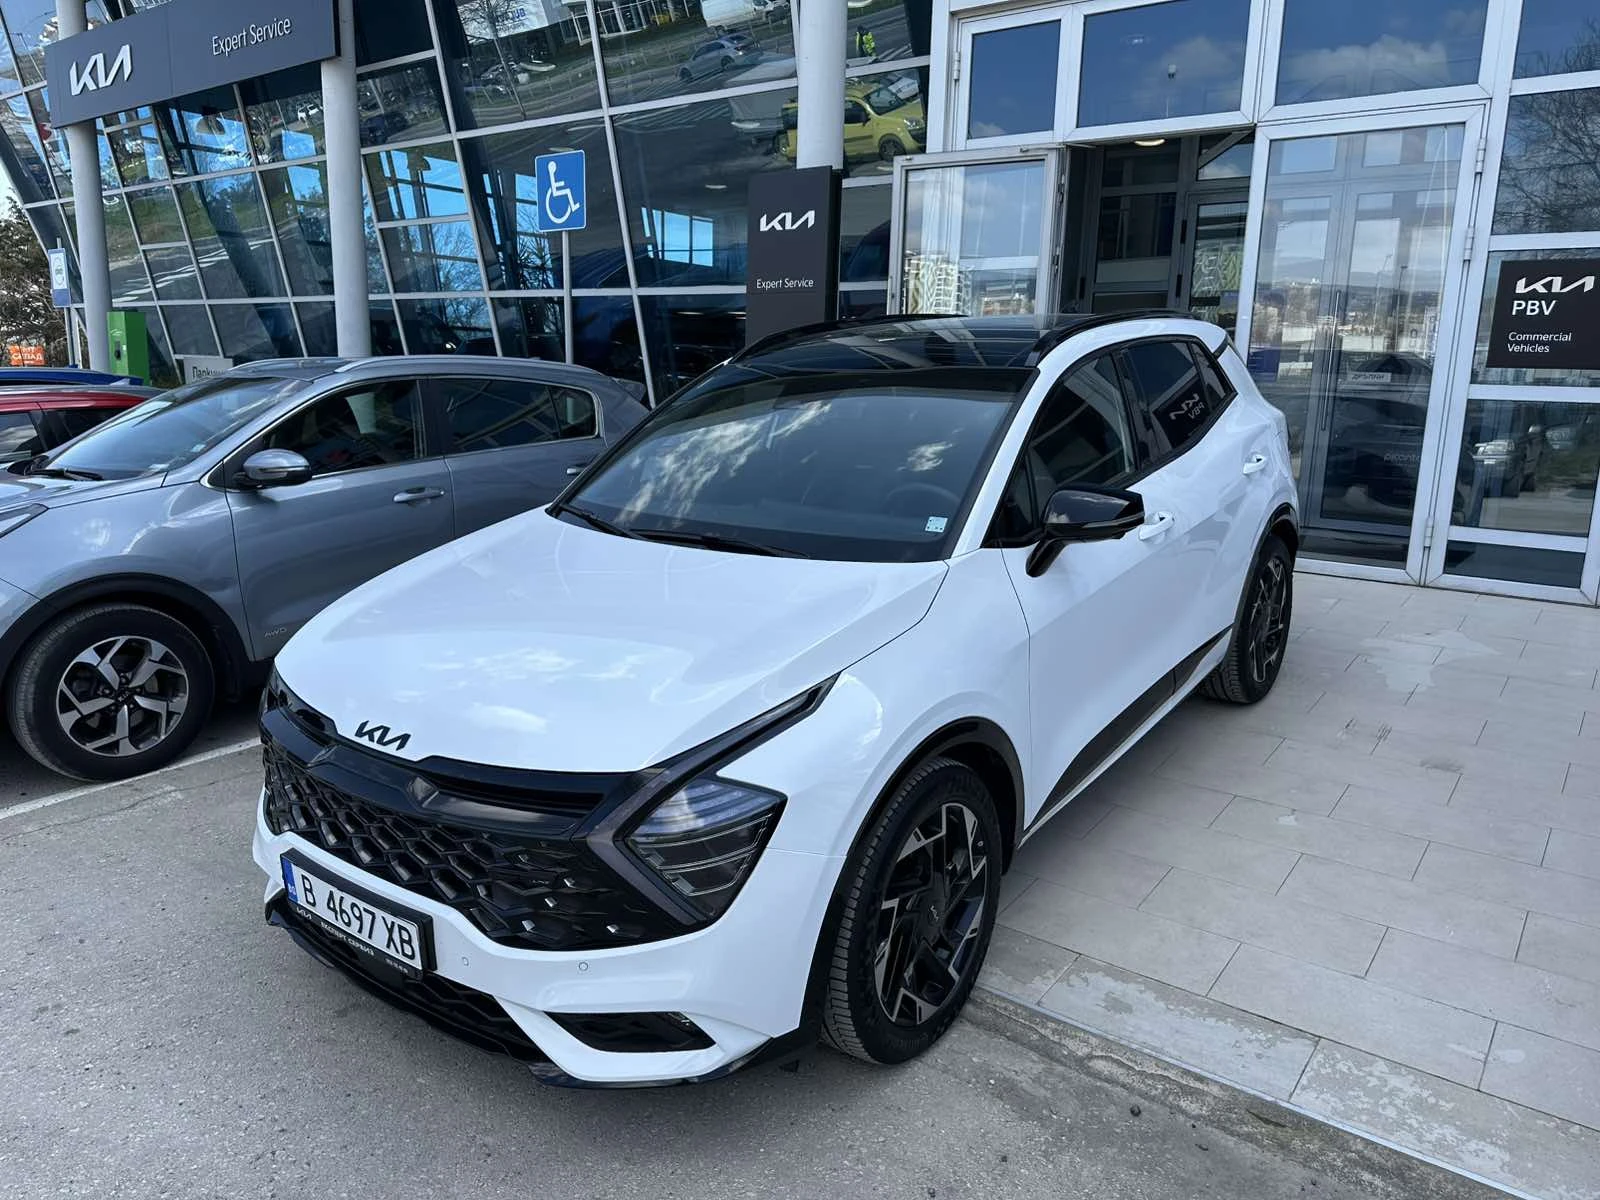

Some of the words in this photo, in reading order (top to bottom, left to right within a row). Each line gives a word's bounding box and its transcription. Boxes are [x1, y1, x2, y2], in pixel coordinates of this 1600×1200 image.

[211, 28, 247, 56] Expert
[249, 16, 292, 45] Service
[69, 44, 133, 96] KIA
[759, 210, 815, 231] KIA
[756, 279, 782, 290] Expert
[784, 278, 814, 288] Service
[1515, 275, 1595, 293] KIA
[1511, 300, 1556, 315] PBV
[1508, 331, 1572, 341] Commercial
[1507, 343, 1550, 353] Vehicles
[354, 720, 411, 751] KIA
[301, 874, 316, 907] B
[326, 890, 376, 940] 4697
[381, 915, 415, 960] XB
